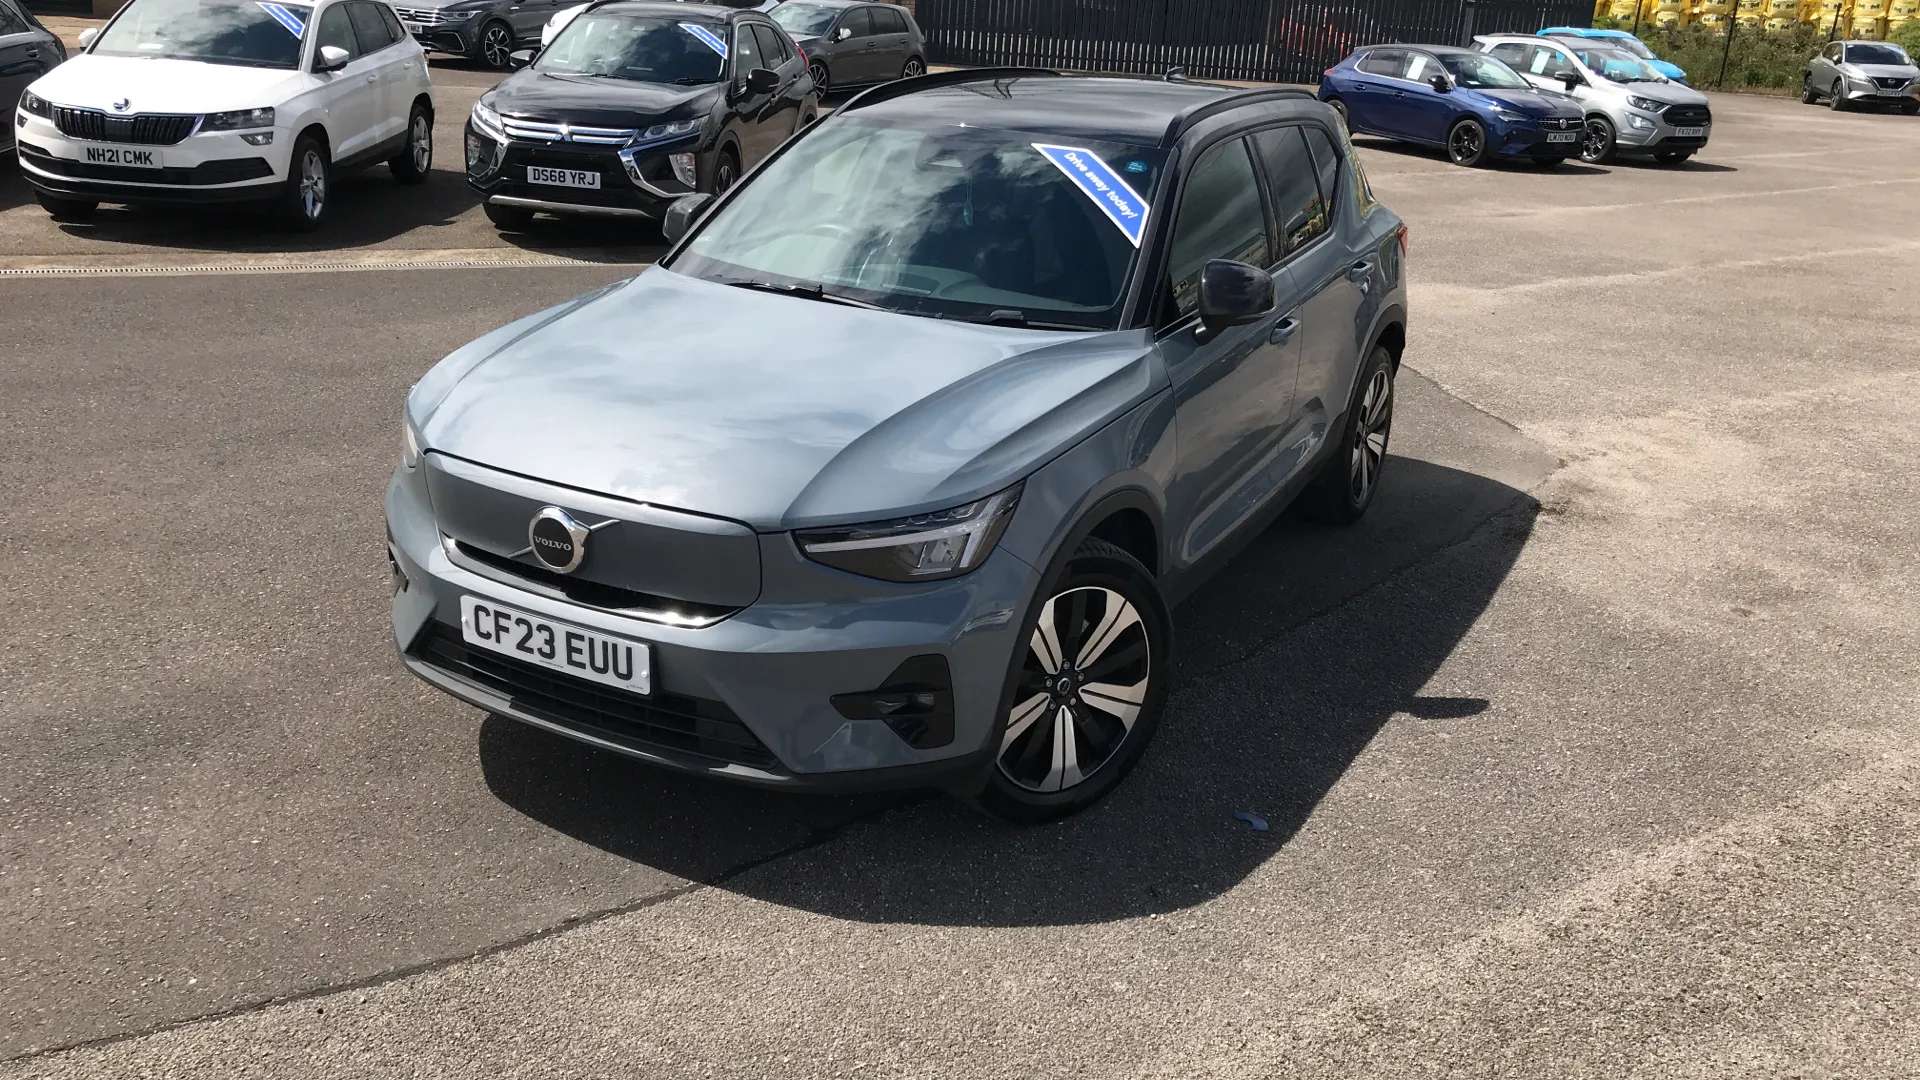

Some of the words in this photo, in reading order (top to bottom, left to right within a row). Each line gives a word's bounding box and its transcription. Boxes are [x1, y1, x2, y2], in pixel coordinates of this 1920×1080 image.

[87, 147, 120, 163] NH21
[123, 150, 153, 165] CMK
[532, 168, 566, 183] DS68
[570, 171, 596, 186] YRJ
[1064, 152, 1088, 172] Drive
[1086, 171, 1109, 191] away
[1107, 191, 1138, 219] today!
[533, 536, 572, 551] VOLVO
[473, 604, 556, 660] CF23
[566, 630, 634, 681] EUU
